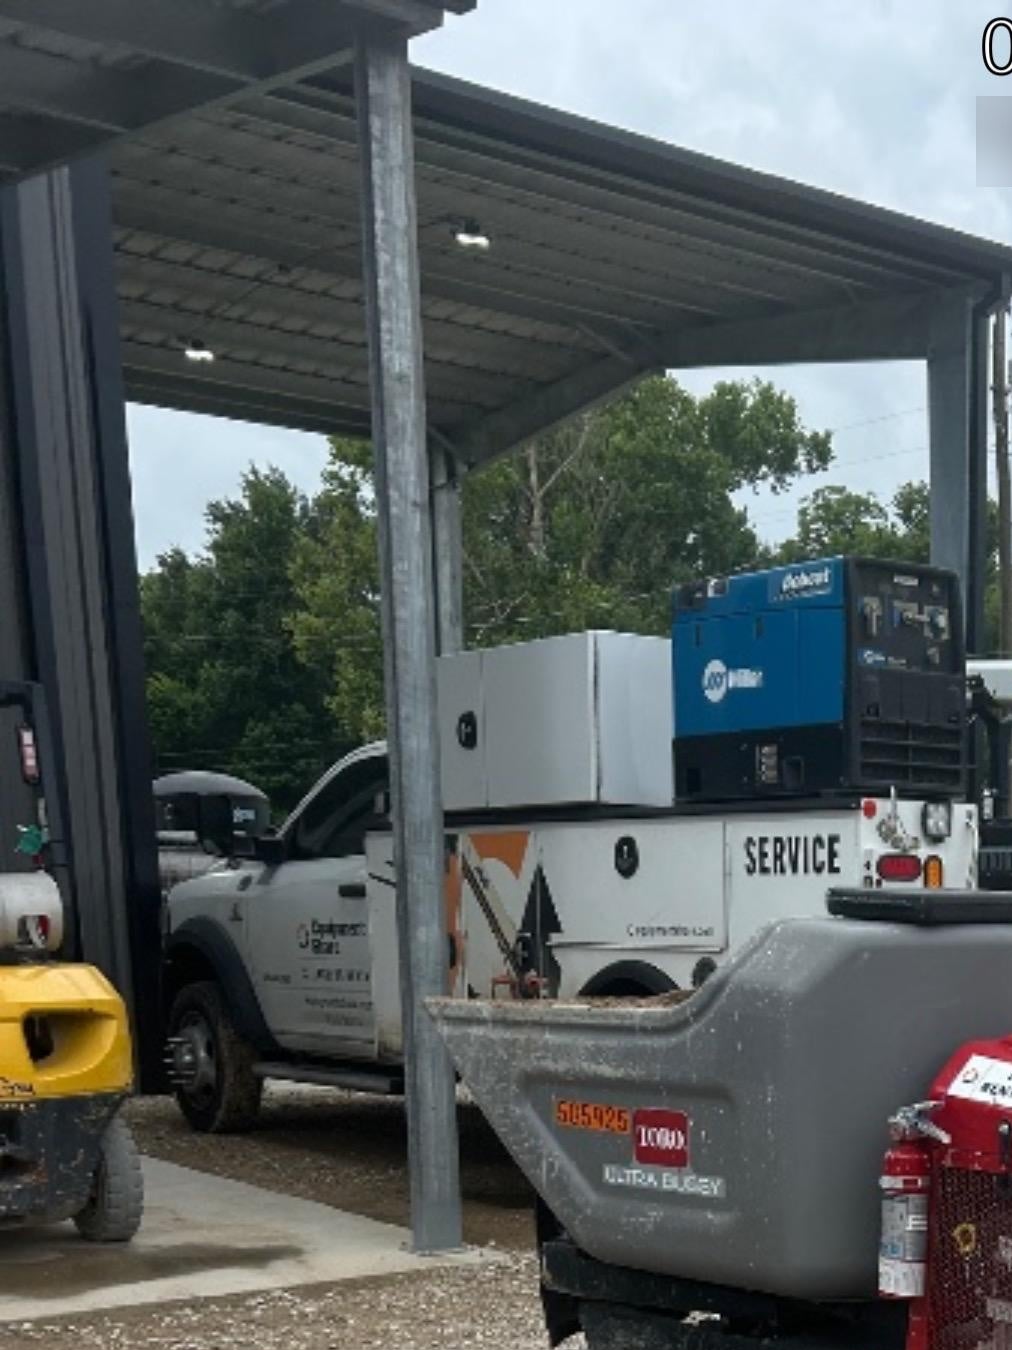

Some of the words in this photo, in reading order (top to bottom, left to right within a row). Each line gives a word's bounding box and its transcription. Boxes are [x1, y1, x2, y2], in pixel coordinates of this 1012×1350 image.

[744, 832, 841, 876] SERVICE
[556, 1100, 629, 1133] 505925
[603, 1165, 658, 1188] ULTRA
[662, 1173, 722, 1196] BUGGY
